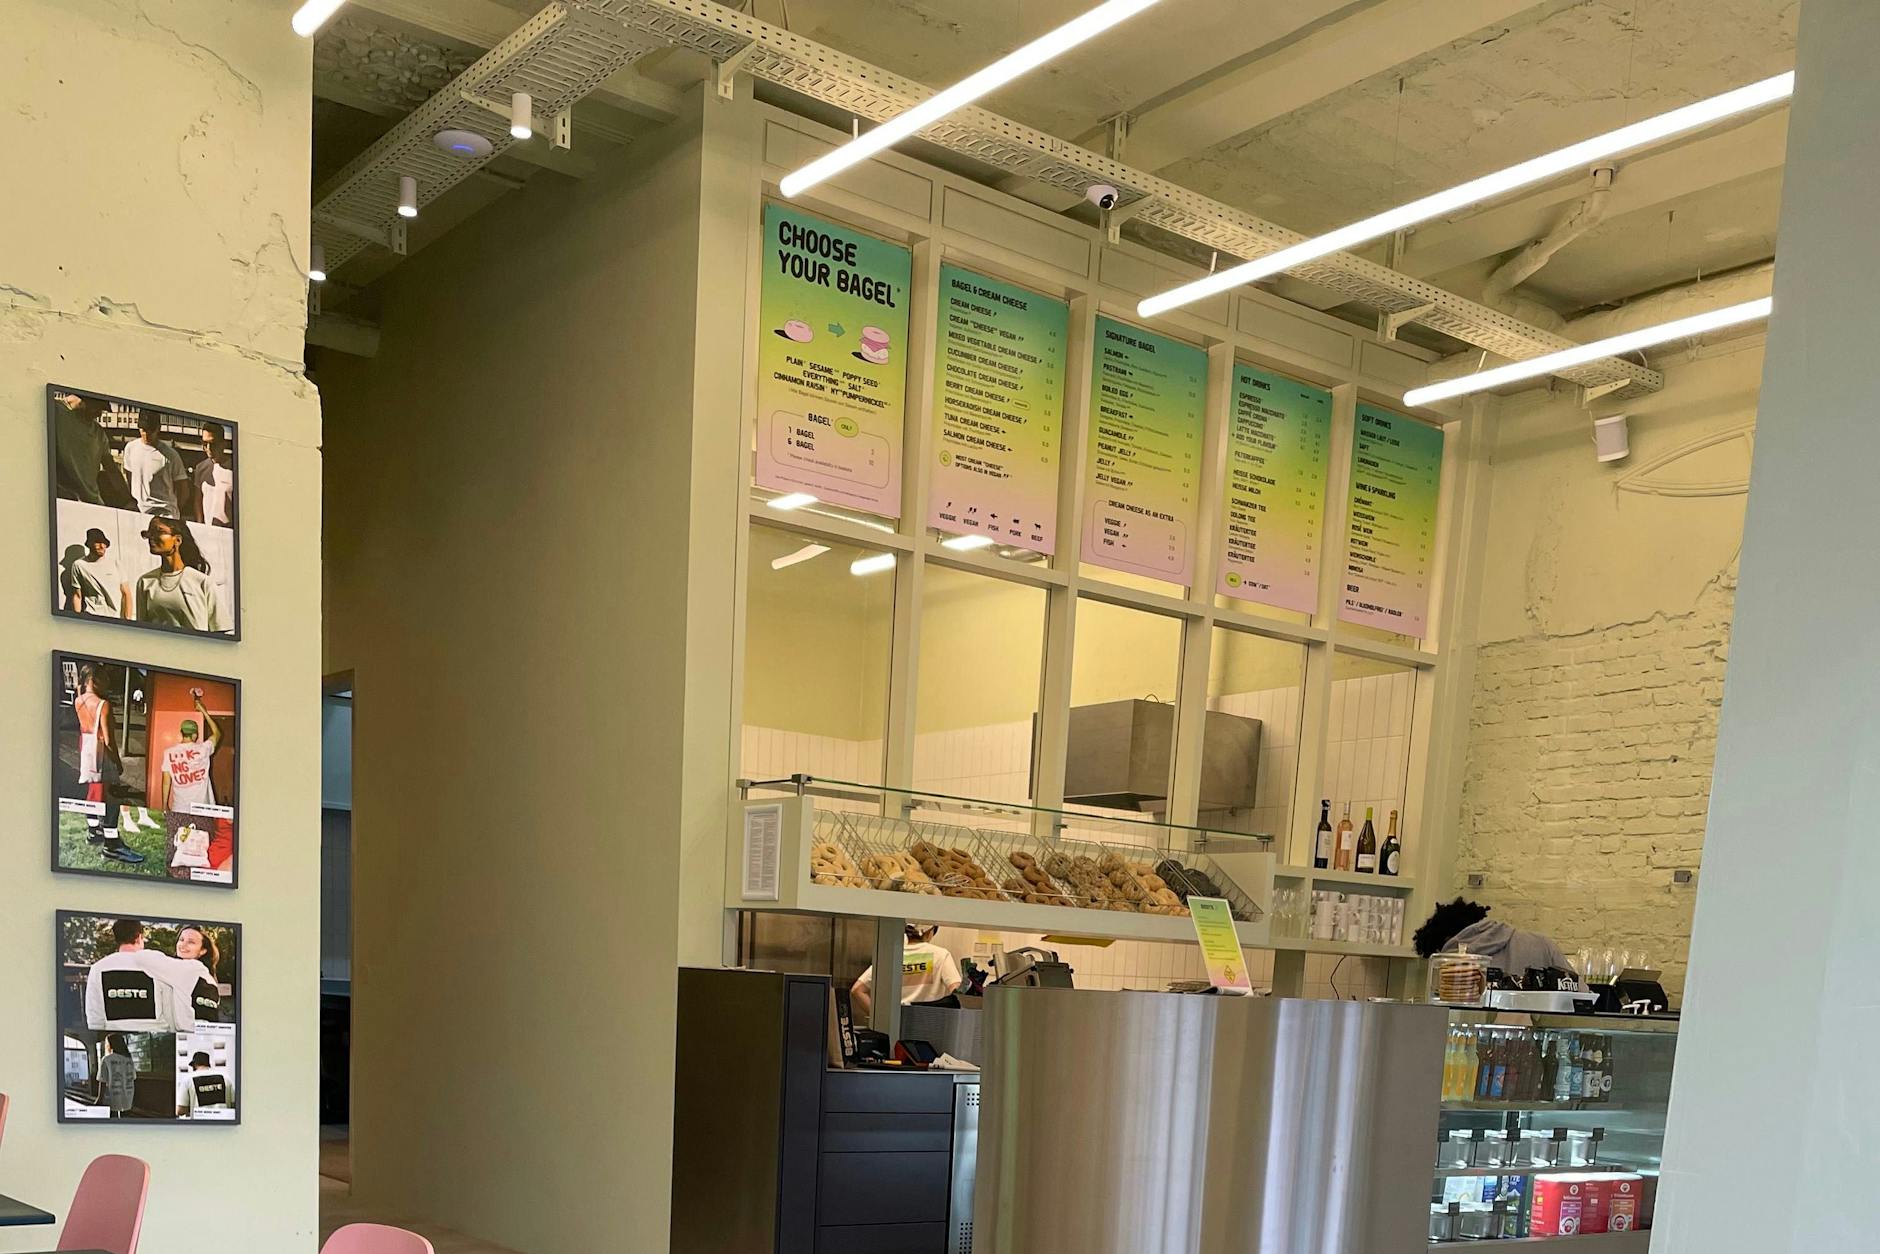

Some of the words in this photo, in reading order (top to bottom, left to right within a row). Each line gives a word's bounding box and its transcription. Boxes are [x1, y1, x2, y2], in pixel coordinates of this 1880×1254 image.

[779, 221, 857, 267] CHOOSE
[778, 249, 830, 287] YOUR
[837, 269, 896, 308] BAGEL
[952, 279, 971, 292] BAGEL
[973, 286, 977, 294] &
[978, 288, 1000, 302] CREAM
[1002, 295, 1027, 310] CHEESE
[950, 297, 969, 309] CREAM
[970, 303, 991, 316] CHEESE
[949, 314, 968, 325] CREAM
[999, 329, 1015, 340] VEGAN
[948, 330, 965, 341] MIXED
[967, 336, 996, 351] VEGETABLE
[998, 346, 1016, 357] CREAM
[1017, 351, 1037, 363] CHEESE
[1105, 329, 1136, 347] SIGNATURE
[1138, 341, 1155, 353] BAGEL
[947, 347, 976, 361] CUCUMBER
[978, 356, 996, 367] CREAM
[997, 362, 1018, 374] CHEESE
[1104, 347, 1123, 359] SALMON
[786, 355, 803, 366] PLAIN
[809, 362, 833, 375] SESAME
[842, 372, 860, 383] POPPY
[863, 377, 878, 388] SEED
[803, 371, 838, 386] EVERYTHING
[848, 383, 861, 392] SALT
[946, 363, 976, 378] CHOCOLATE
[978, 372, 996, 384] CREAM
[998, 378, 1018, 390] CHEESE
[774, 371, 804, 386] CINNAMON
[806, 380, 824, 391] RAISIN
[842, 391, 884, 408] PUMPERNICKEL
[945, 380, 962, 390] BERRY
[964, 385, 983, 396] CREAM
[984, 391, 1005, 402] CHEESE
[808, 412, 831, 426] BAGEL
[944, 412, 958, 422] TUNA
[960, 417, 978, 427] CREAM
[979, 422, 999, 433] CHEESE
[982, 406, 1000, 418] CREAM
[1002, 412, 1022, 424] CHEESE
[1100, 405, 1127, 419] BREAKFAST
[796, 428, 814, 439] BAGEL
[943, 429, 964, 440] SALMON
[966, 435, 984, 446] CREAM
[986, 440, 1005, 451] CHEESE
[796, 439, 814, 450] BAGEL
[1098, 442, 1116, 452] PEANUT
[1118, 447, 1131, 457] JELLY
[968, 457, 981, 465] CREAM
[1096, 457, 1110, 466] JELLY
[1095, 472, 1109, 481] JELLY
[1110, 476, 1125, 485] VEGAN
[1108, 499, 1124, 509] CREAM
[1126, 504, 1143, 514] CHEESE
[1159, 513, 1173, 522] EXTRA
[939, 512, 956, 521] VEGGIE
[963, 518, 978, 527] VEGAN
[1031, 534, 1042, 542] BEEF
[1104, 528, 1119, 537] VEGAN
[902, 962, 927, 973] ESTE
[107, 988, 148, 999] BESTE
[841, 1016, 854, 1057] BESTE
